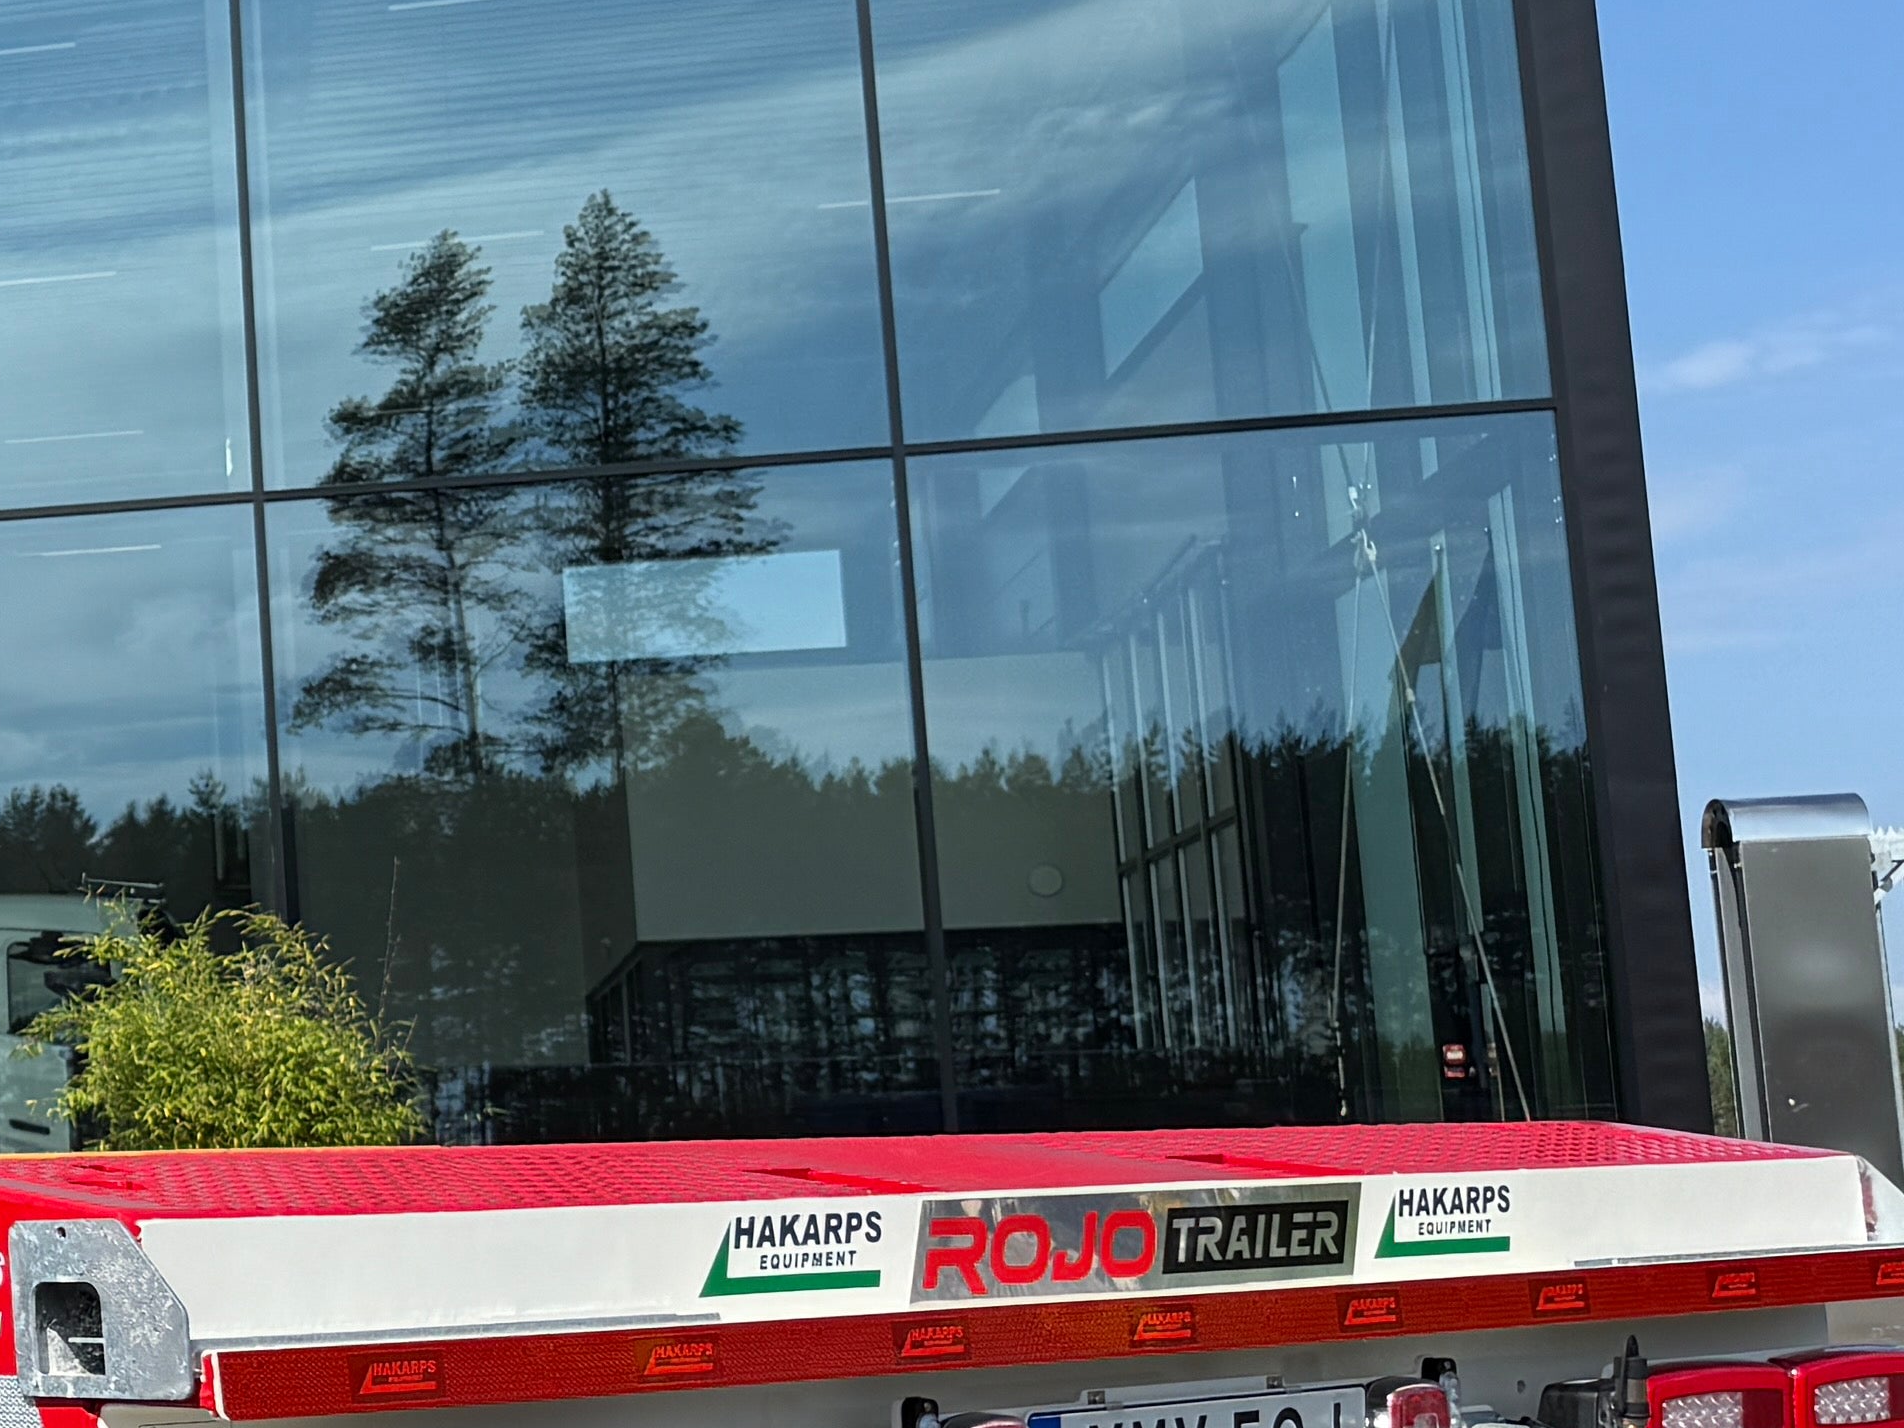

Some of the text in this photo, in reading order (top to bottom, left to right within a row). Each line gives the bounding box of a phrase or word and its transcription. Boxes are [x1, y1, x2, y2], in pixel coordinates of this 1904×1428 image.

[1397, 1185, 1511, 1218] HAKARPS
[732, 1211, 883, 1252] HAKARPS
[1418, 1217, 1492, 1236] EQUIPMENT
[759, 1249, 858, 1271] EQUIPMENT
[922, 1208, 1341, 1295] ROJO TRAILER
[373, 1360, 436, 1376] HAKARPS
